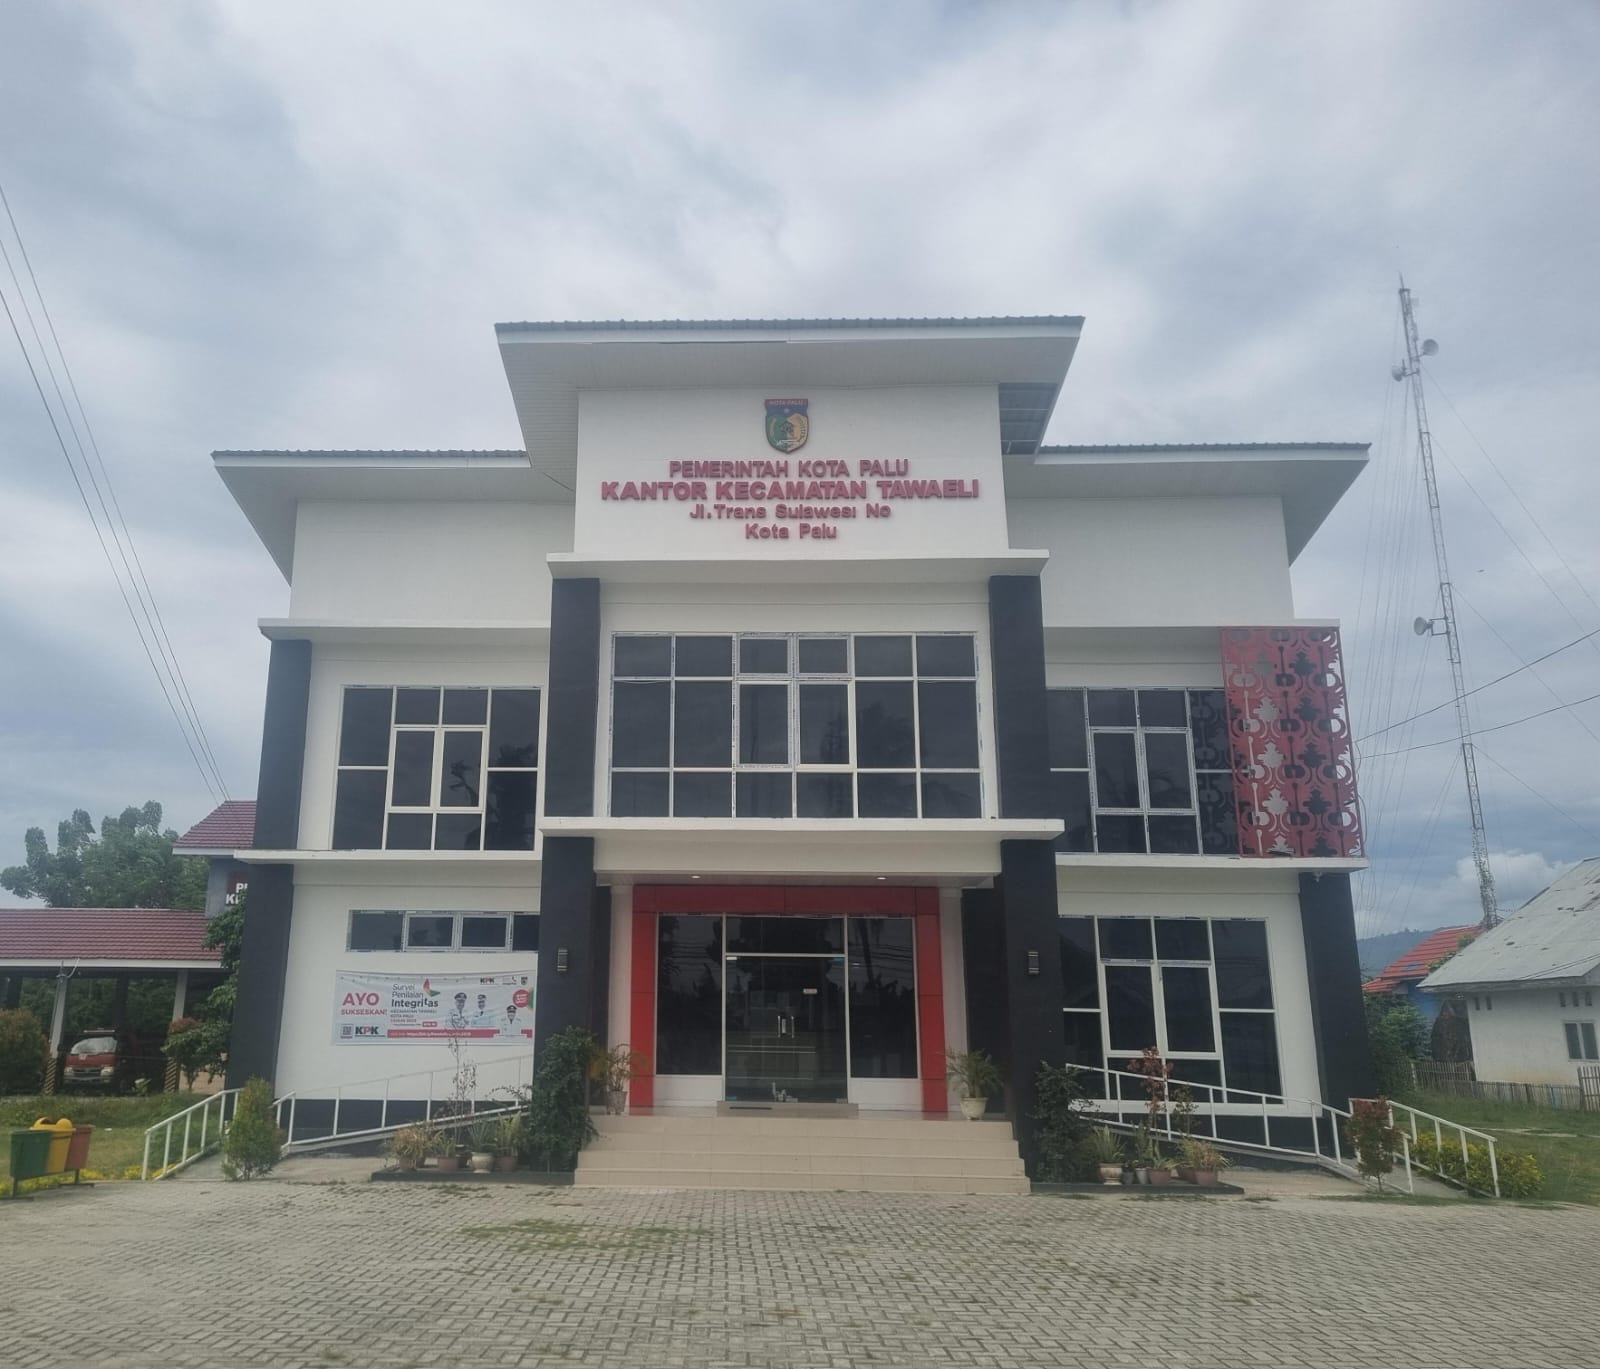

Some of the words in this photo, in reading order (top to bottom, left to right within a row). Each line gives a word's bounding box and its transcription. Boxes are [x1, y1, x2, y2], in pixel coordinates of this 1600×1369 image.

[669, 460, 789, 478] PEMERINTAH
[798, 460, 850, 478] KOTA
[859, 459, 909, 476] PALU
[601, 481, 708, 500] KANTOR
[715, 481, 868, 500] KECAMATAN
[876, 479, 980, 498] TAWAELI
[775, 504, 857, 518] Sulawesi
[866, 503, 892, 518] No
[745, 524, 789, 539] Kota
[799, 523, 838, 539] Palu
[342, 992, 380, 1006] AYO
[391, 991, 424, 999] Penilaian
[391, 998, 439, 1009] Integritas
[355, 1025, 379, 1035] KPK
